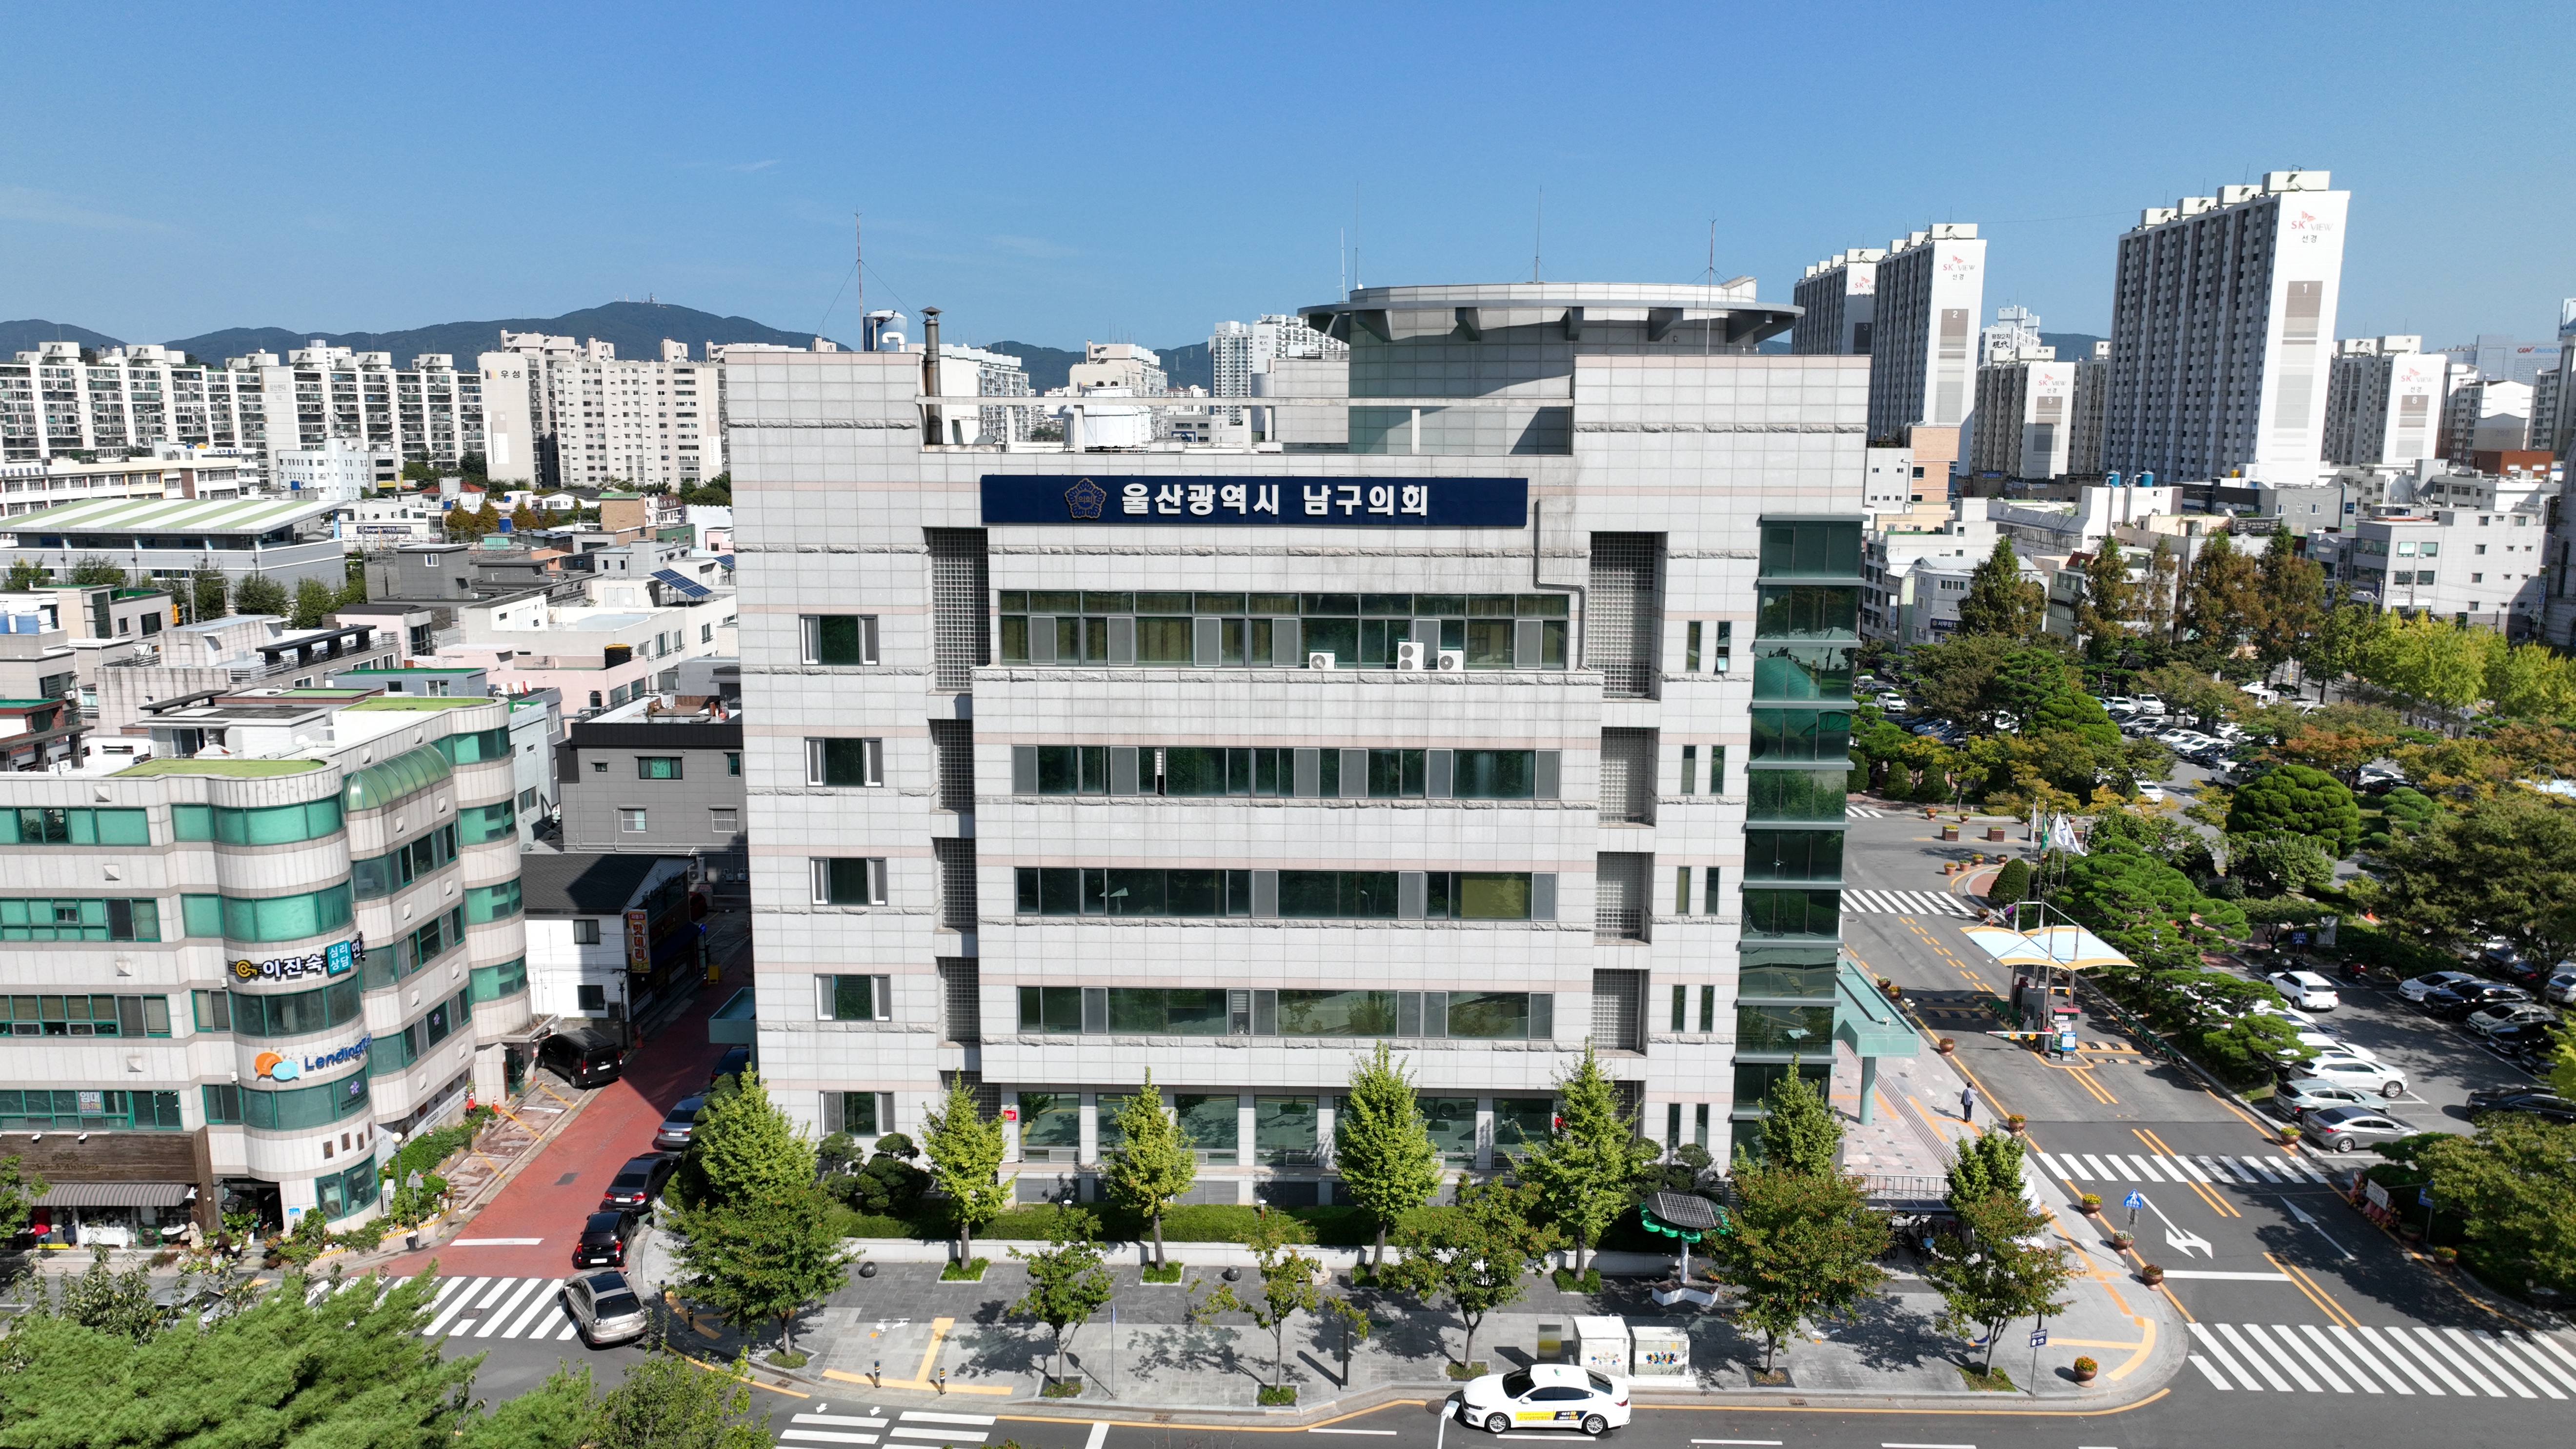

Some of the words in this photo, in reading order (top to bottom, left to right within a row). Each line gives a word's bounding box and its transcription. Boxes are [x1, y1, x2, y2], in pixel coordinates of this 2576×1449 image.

[2291, 221, 2306, 230] SK
[2302, 235, 2317, 243] 선경
[2303, 283, 2308, 294] 1
[501, 370, 520, 379] 우성
[1077, 495, 1093, 504] 의회
[1122, 483, 1279, 516] 울산광역시
[1303, 484, 1428, 516] 남구의회
[329, 942, 348, 959] 심리
[262, 954, 323, 978] 이진숙
[330, 954, 350, 971] 상담
[79, 1091, 101, 1103] 임대
